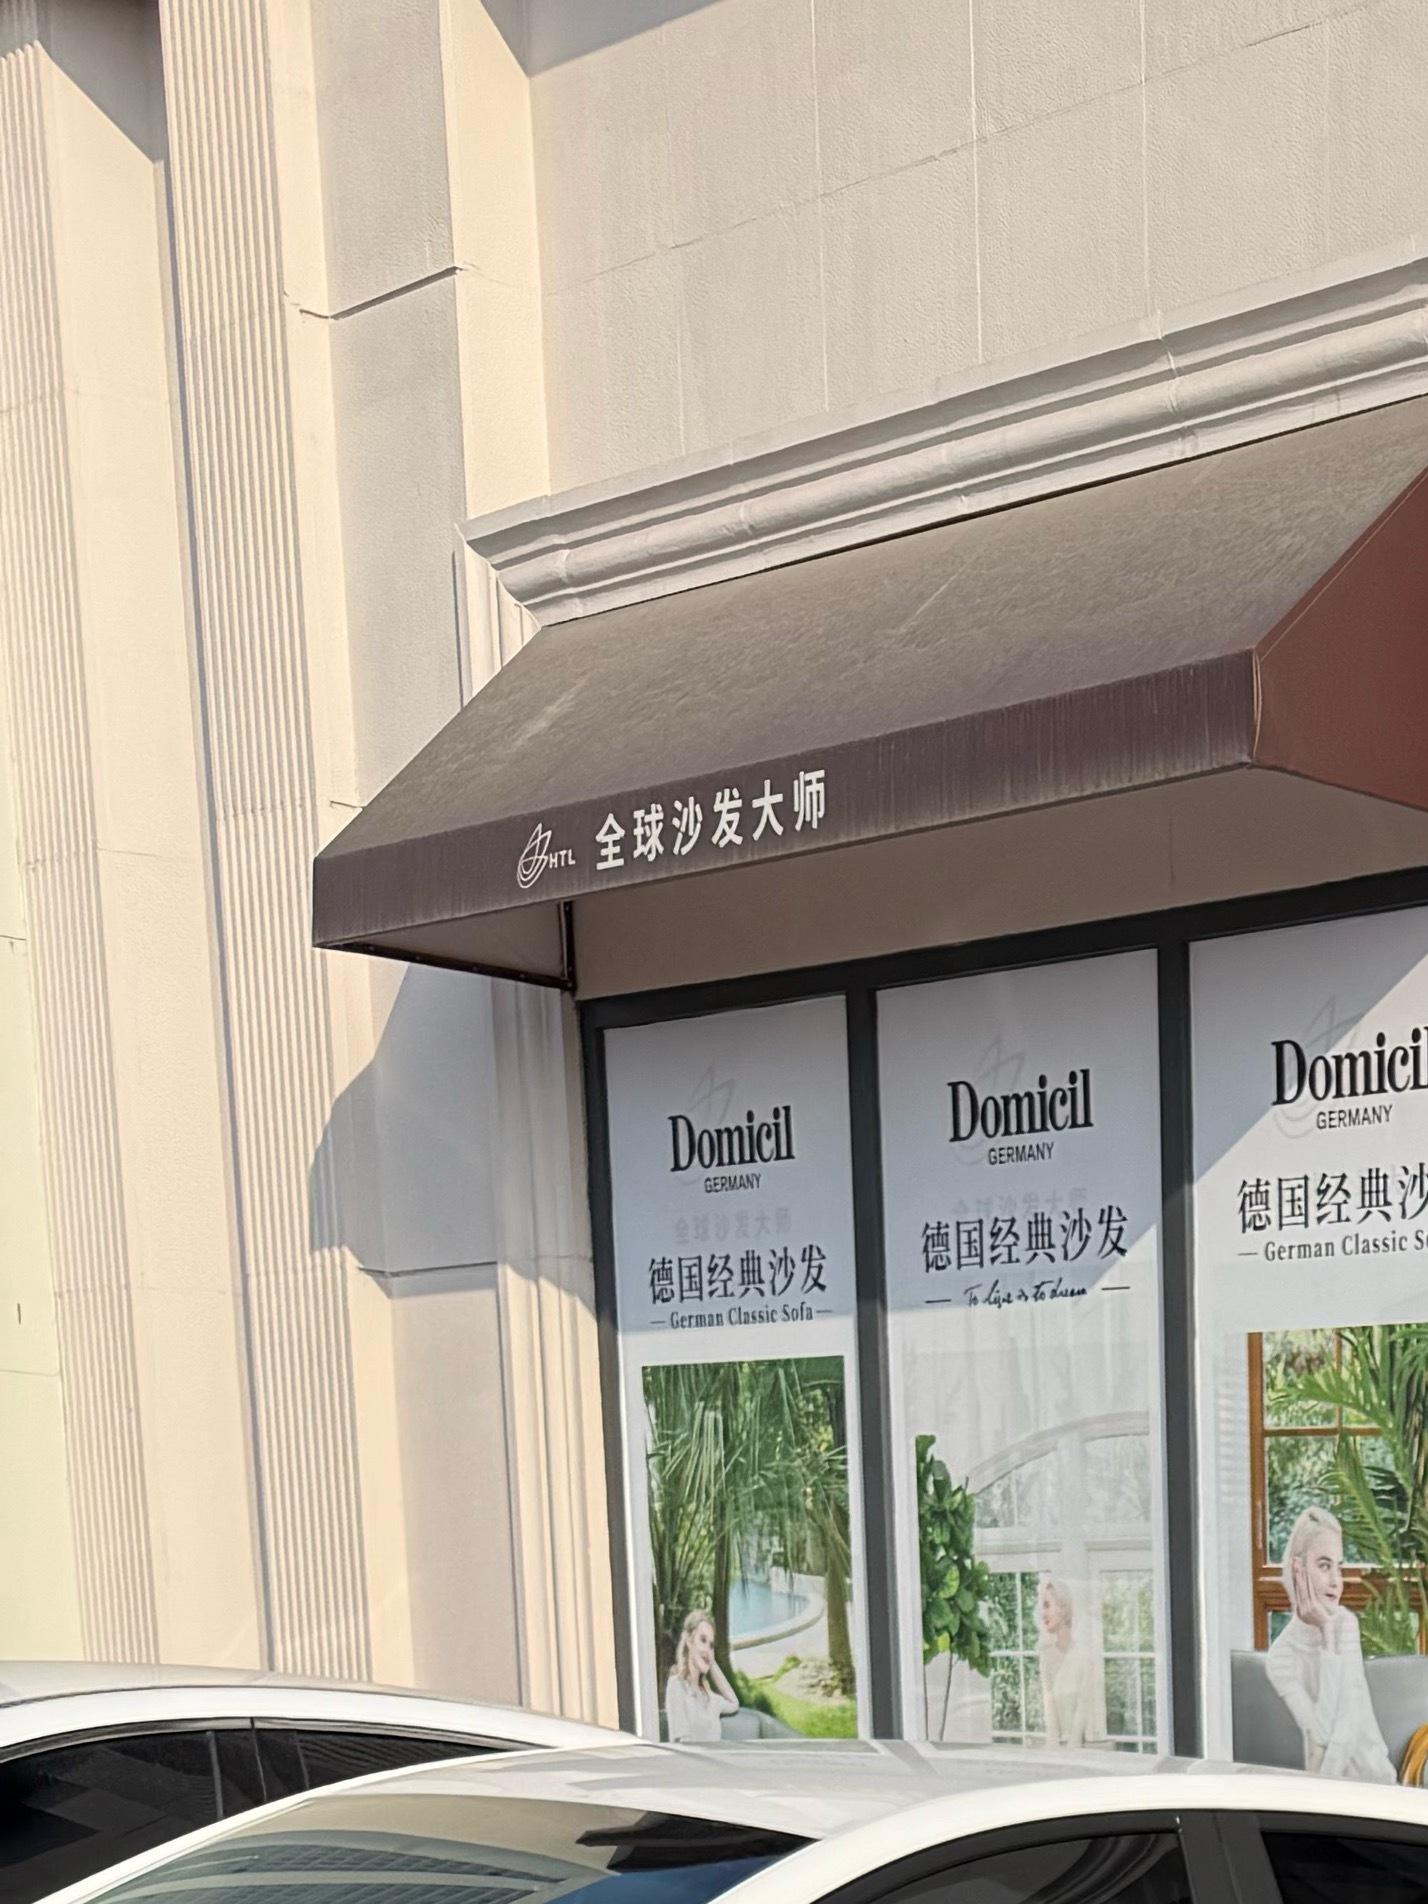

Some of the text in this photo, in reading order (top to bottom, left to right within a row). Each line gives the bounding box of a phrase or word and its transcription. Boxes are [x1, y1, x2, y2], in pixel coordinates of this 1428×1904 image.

[595, 769, 826, 870] 全球沙发大师
[549, 849, 576, 869] HTL
[946, 1068, 1094, 1142] Domicil
[1316, 1104, 1393, 1130] GERMANY
[667, 1105, 796, 1172] Domicil
[988, 1141, 1055, 1165] GERMANY
[704, 1173, 762, 1194] GERMANY
[921, 1205, 1129, 1274] 德国经典沙发
[1264, 1239, 1335, 1262] German
[1341, 1230, 1409, 1256] Classic
[649, 1244, 827, 1305] 德国经典沙发
[670, 1301, 814, 1330] German Classic Sofa
